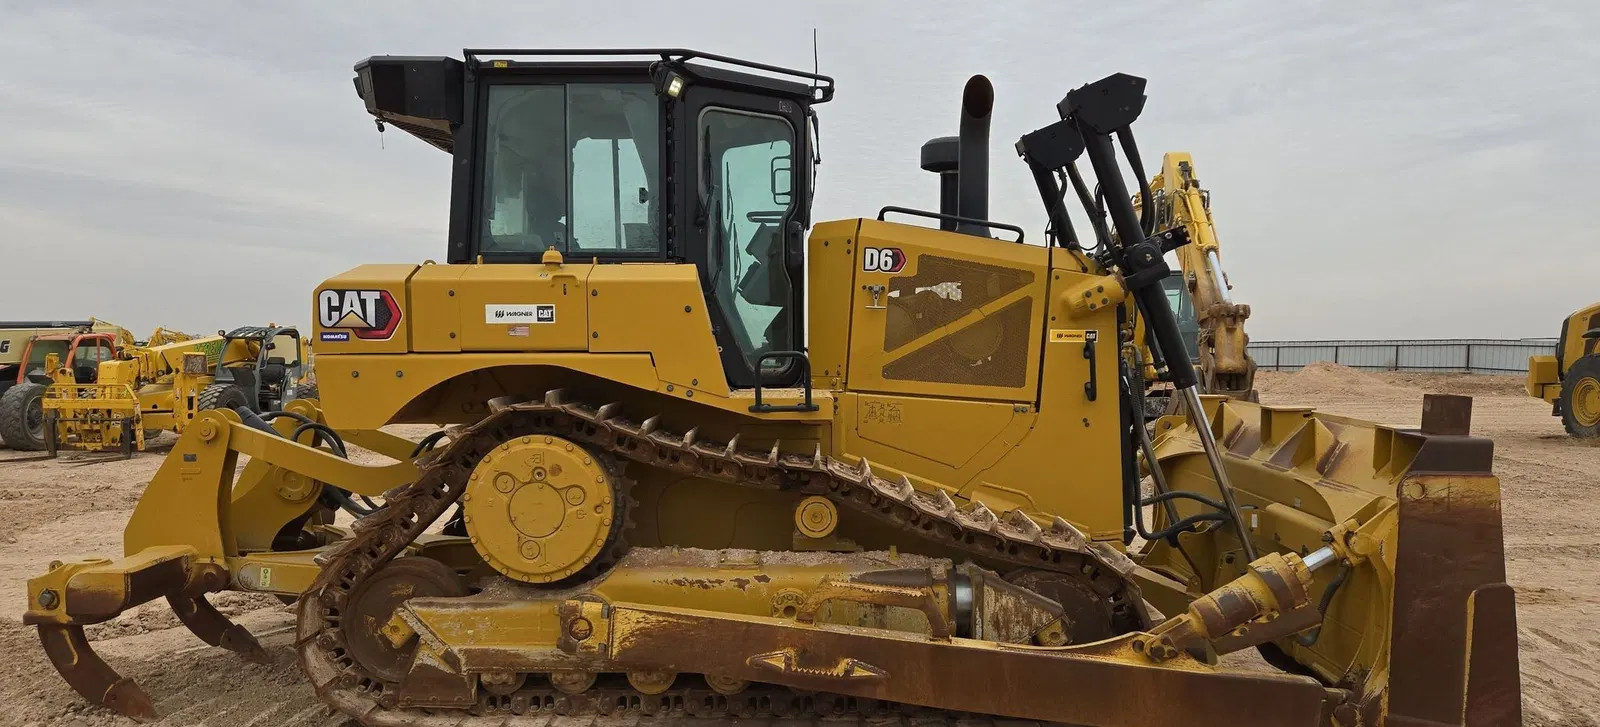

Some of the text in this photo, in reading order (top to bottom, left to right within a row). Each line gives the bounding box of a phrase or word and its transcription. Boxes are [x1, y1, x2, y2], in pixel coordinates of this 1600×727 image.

[865, 248, 893, 271] D6
[319, 289, 380, 328] CAT
[538, 309, 553, 318] CAT
